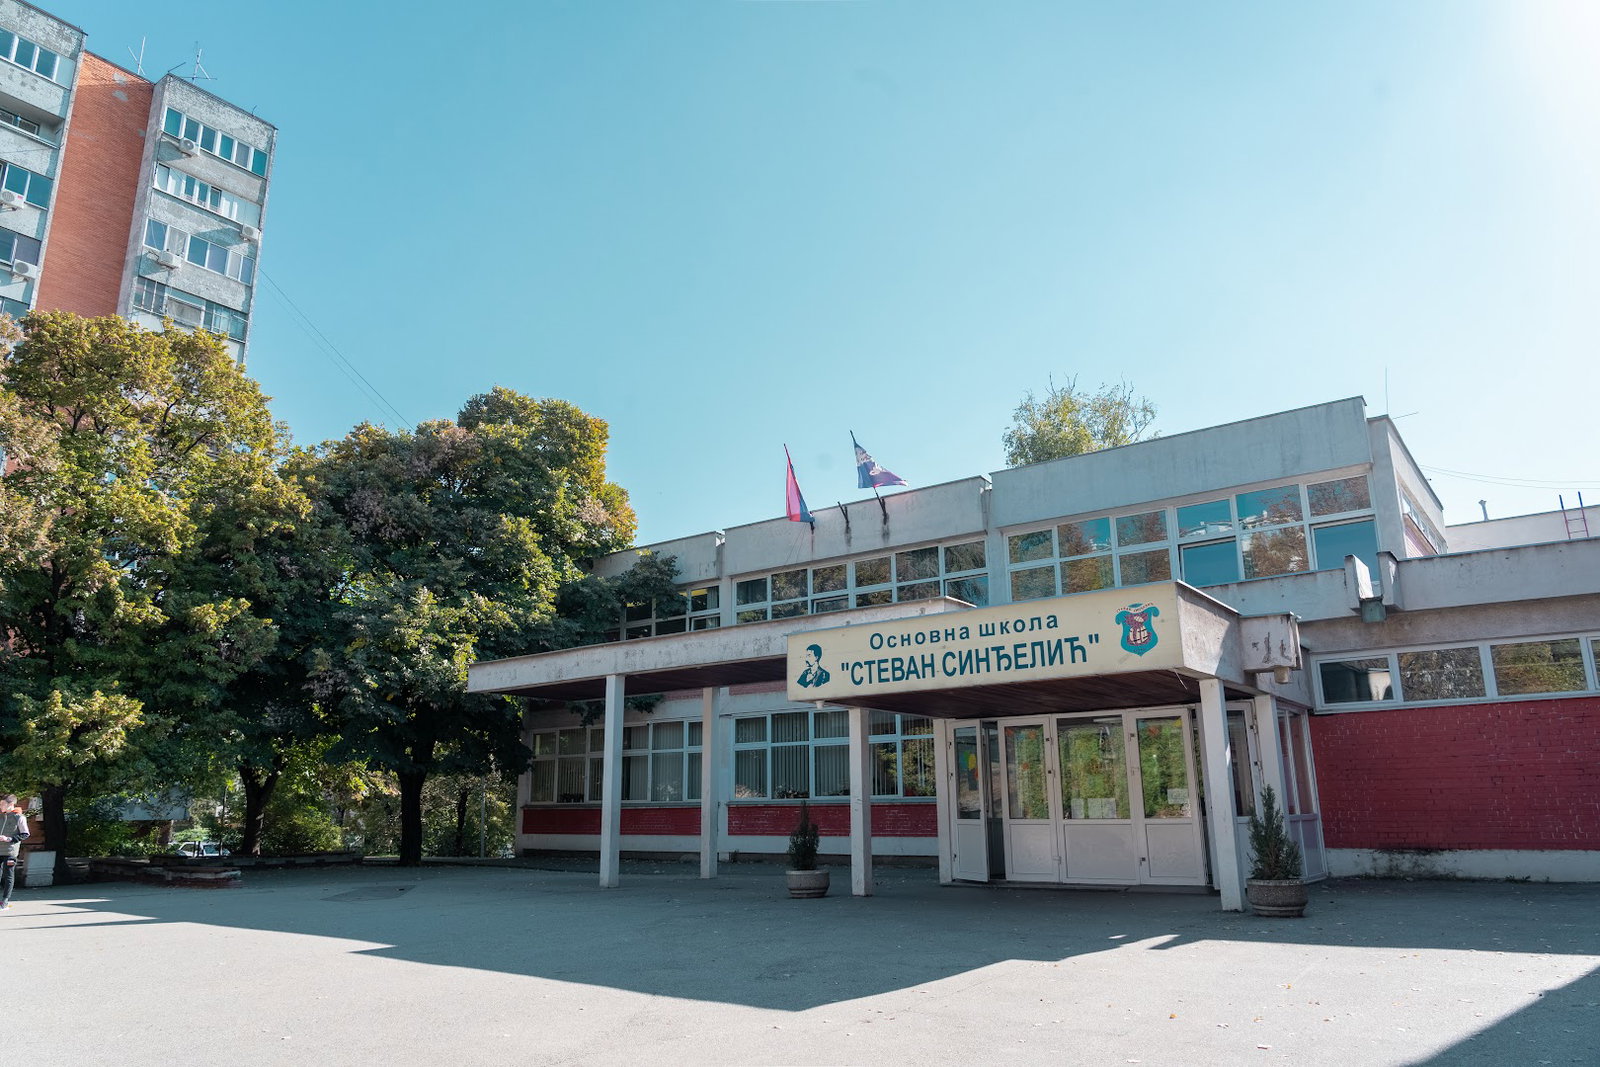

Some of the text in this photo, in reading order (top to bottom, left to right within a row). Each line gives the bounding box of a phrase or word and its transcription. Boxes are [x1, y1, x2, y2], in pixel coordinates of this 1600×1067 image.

[869, 614, 1059, 650] Основна школа
[841, 653, 936, 686] "СТЕВАН
